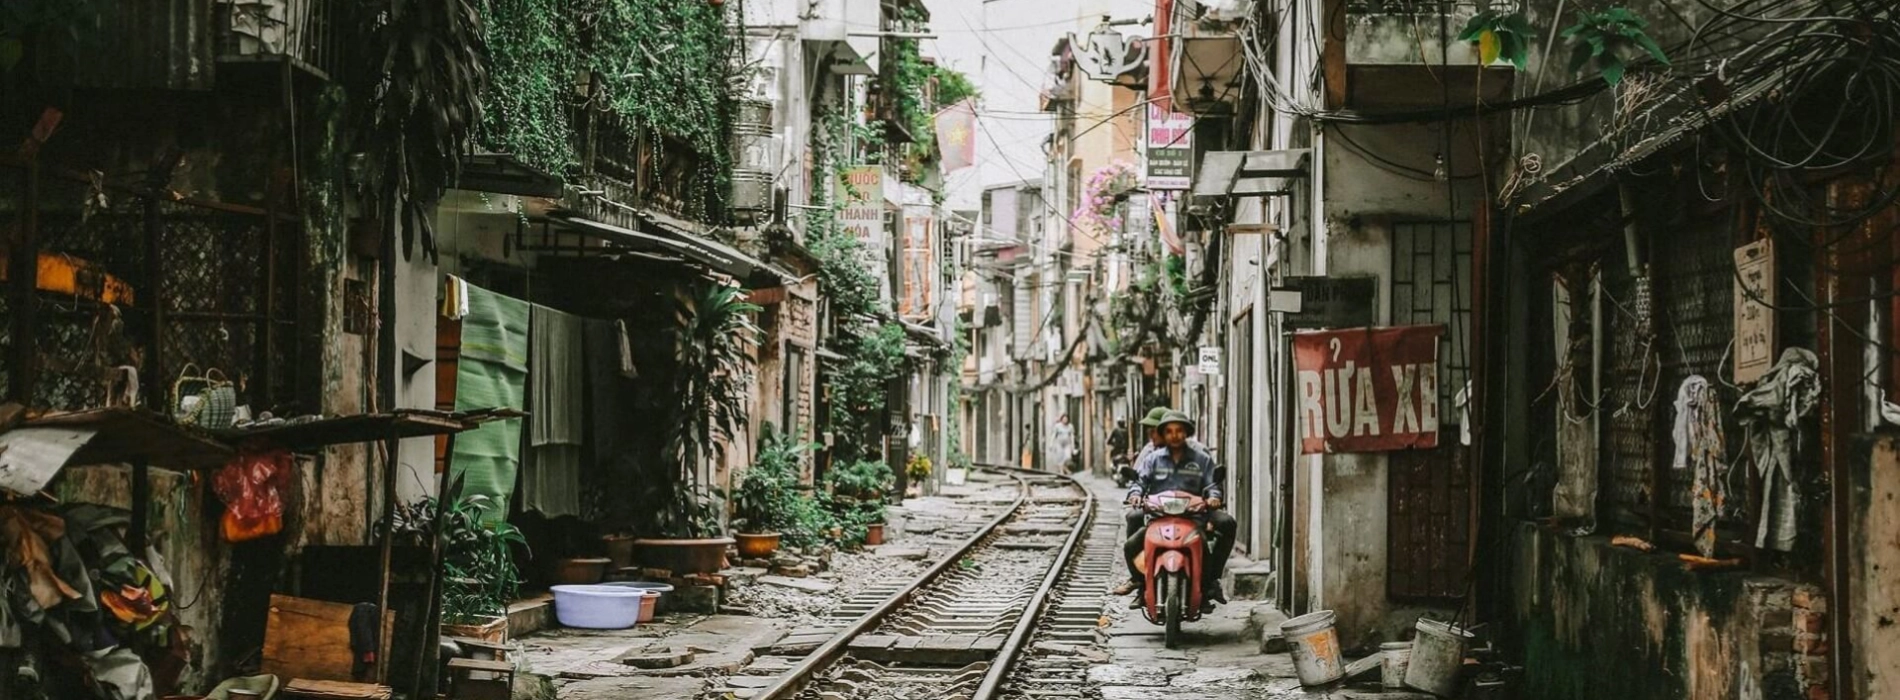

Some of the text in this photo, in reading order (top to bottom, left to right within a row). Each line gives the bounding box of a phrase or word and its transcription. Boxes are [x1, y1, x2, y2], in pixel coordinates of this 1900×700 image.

[840, 208, 878, 220] THANH
[1298, 338, 1437, 439] RỬA XE
